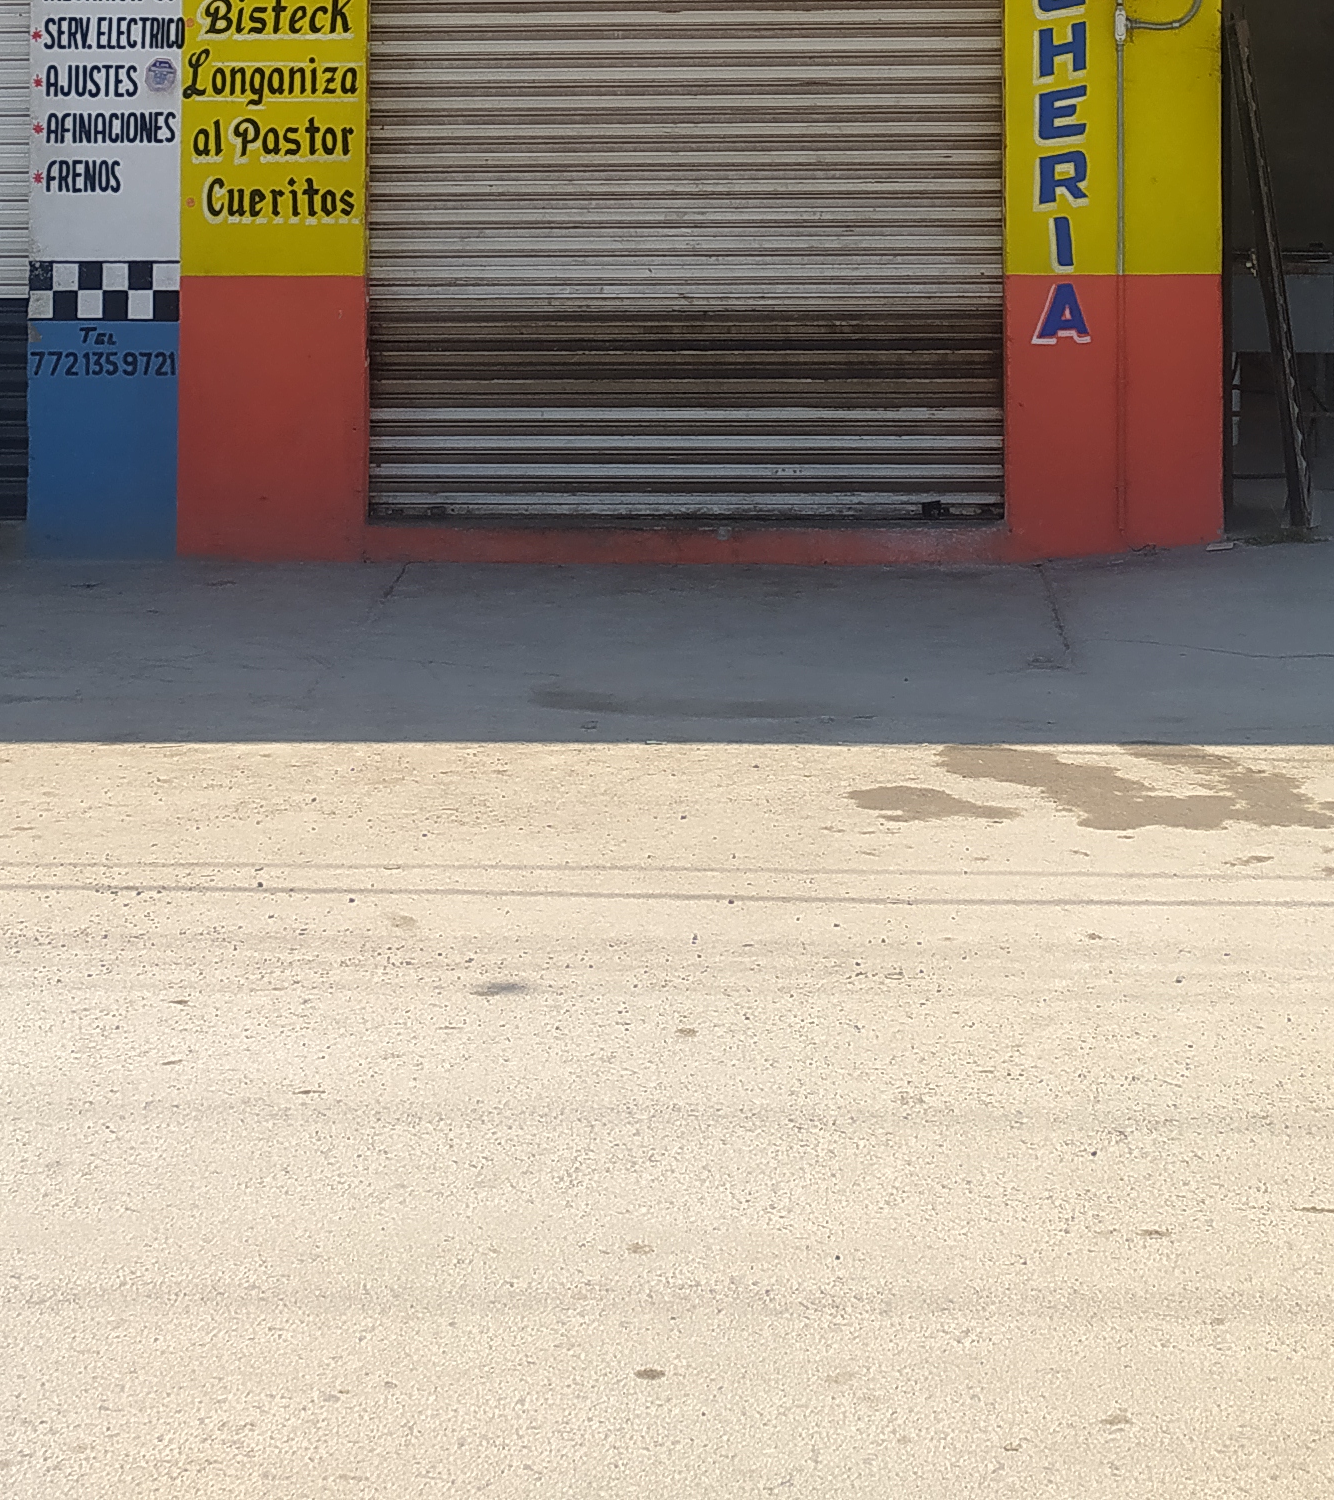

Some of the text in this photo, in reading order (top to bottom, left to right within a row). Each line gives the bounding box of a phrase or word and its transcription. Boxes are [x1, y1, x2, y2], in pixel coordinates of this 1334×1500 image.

[44, 17, 186, 50] SERV. ELECTRICO
[45, 65, 138, 98] AJUSTES
[182, 48, 359, 108] Longaniza
[45, 112, 176, 145] AFINACIONES
[192, 117, 355, 157] al Pastor
[45, 160, 121, 193] FRENOS
[207, 177, 356, 218] Cueritos
[30, 351, 177, 377] 7721359721
